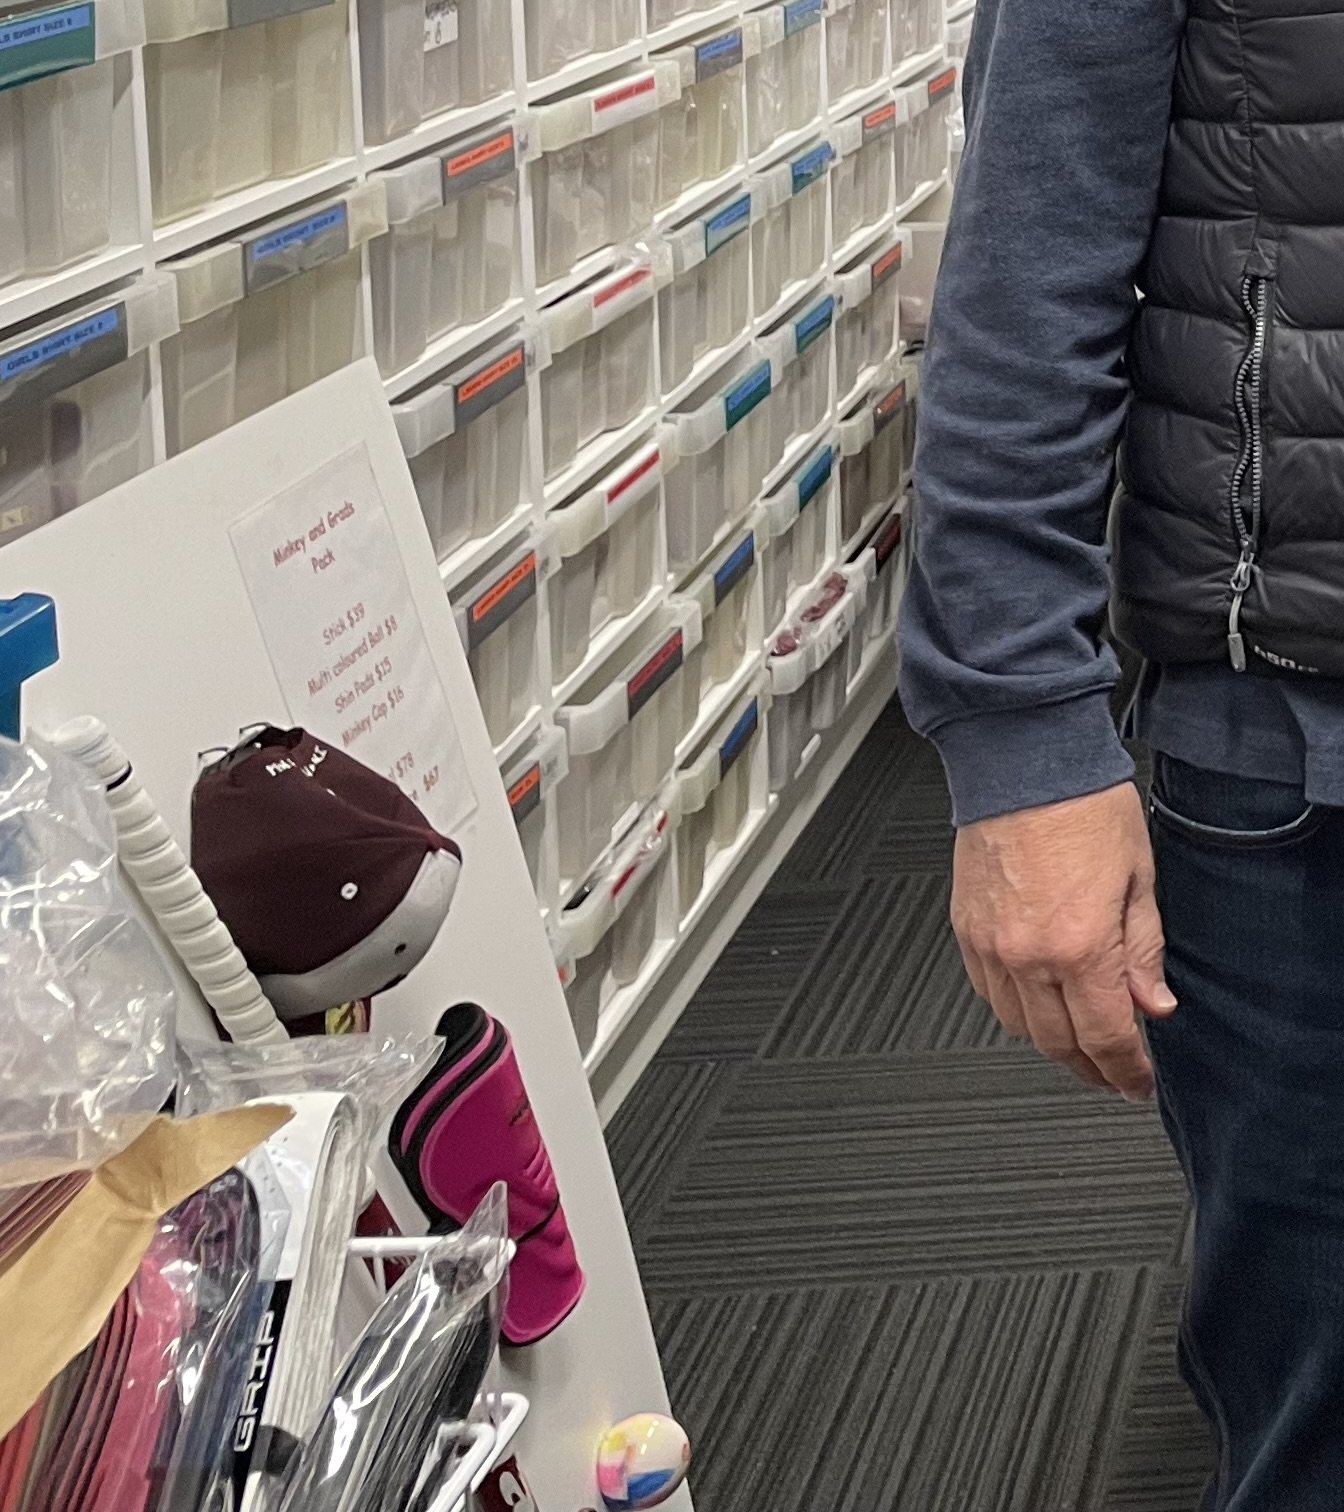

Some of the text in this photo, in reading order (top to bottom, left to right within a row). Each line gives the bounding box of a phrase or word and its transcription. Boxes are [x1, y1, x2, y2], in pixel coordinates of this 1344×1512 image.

[308, 515, 326, 542] and
[311, 547, 336, 574] Pack
[322, 602, 365, 646] Stick $39
[307, 614, 398, 697] Multi coloured Ball $8
[375, 656, 392, 682] $15
[371, 702, 388, 722] Cap
[387, 685, 404, 709] $16
[233, 1310, 275, 1453] GRIP
